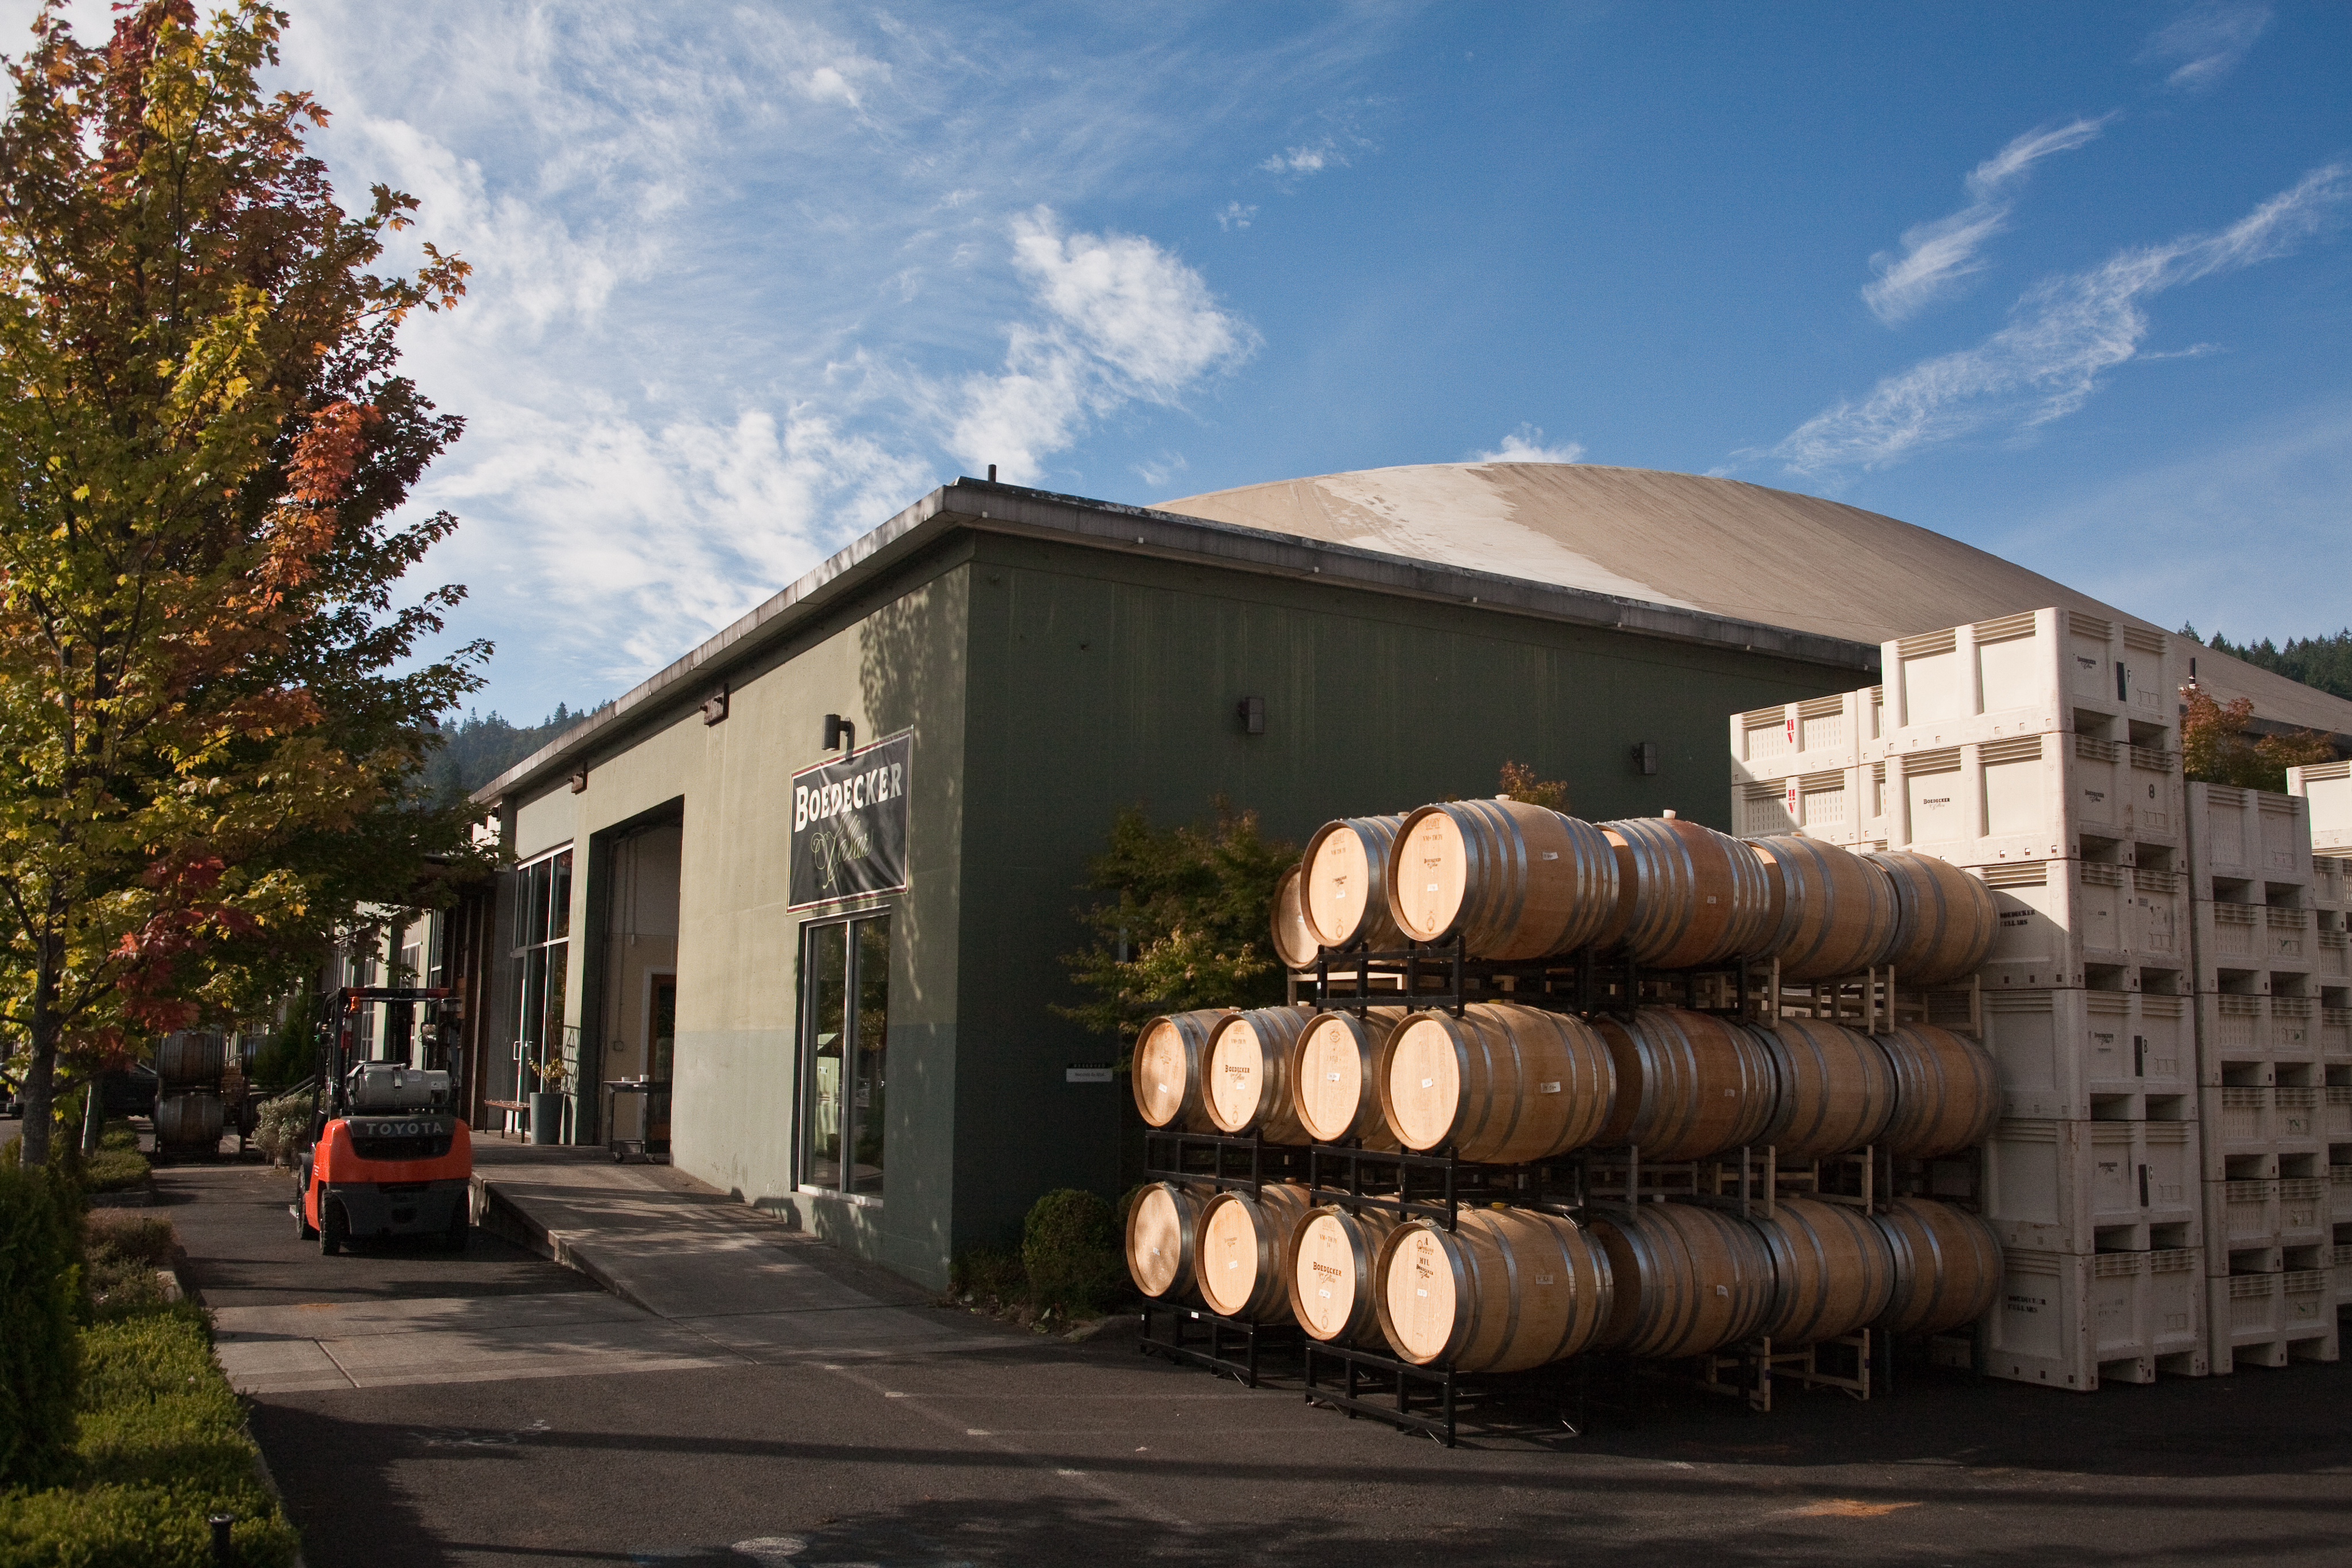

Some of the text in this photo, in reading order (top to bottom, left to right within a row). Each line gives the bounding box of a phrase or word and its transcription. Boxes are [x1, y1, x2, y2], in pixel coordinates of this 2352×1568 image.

[2127, 669, 2131, 683] F
[795, 762, 902, 833] BOEDECKER
[1225, 1064, 1250, 1073] BOEDECKER
[366, 1122, 443, 1136] TOYOTA
[1313, 1261, 1342, 1277] BOEDECKER
